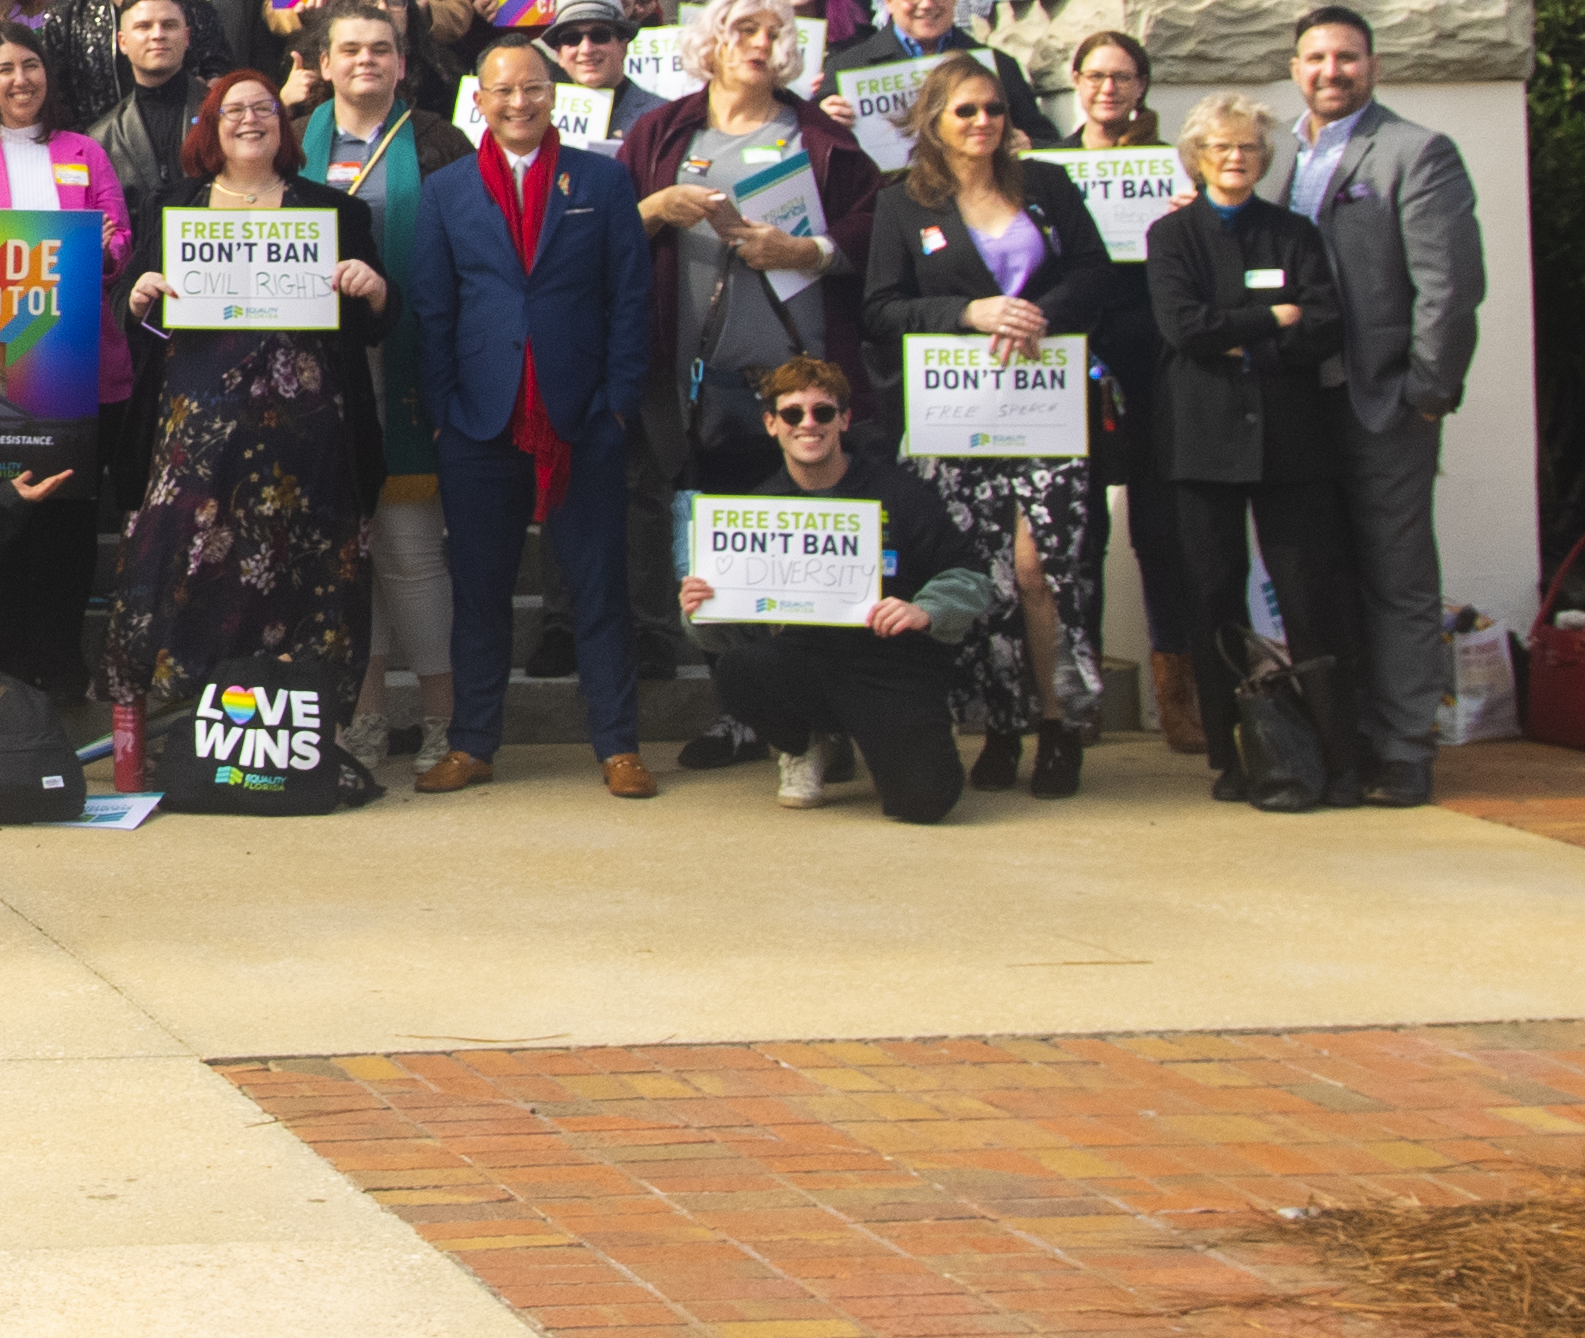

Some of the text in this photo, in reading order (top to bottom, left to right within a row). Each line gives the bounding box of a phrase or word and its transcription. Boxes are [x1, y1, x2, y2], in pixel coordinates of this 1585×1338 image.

[856, 73, 907, 97] FREE
[1097, 160, 1174, 178] STATES
[1121, 179, 1173, 199] BAN
[180, 221, 320, 239] FREE STATES
[181, 241, 318, 263] DON'T BAN
[183, 269, 333, 297] CIVIL RIGHTS
[924, 348, 980, 366] FREE
[925, 369, 1066, 390] DON'T BAN
[711, 509, 860, 532] FREE STATES
[712, 530, 858, 556] DON'T BAN
[195, 720, 321, 770] WINS
[244, 782, 285, 791] FLORIDA
[245, 773, 286, 784] EQUALITY
